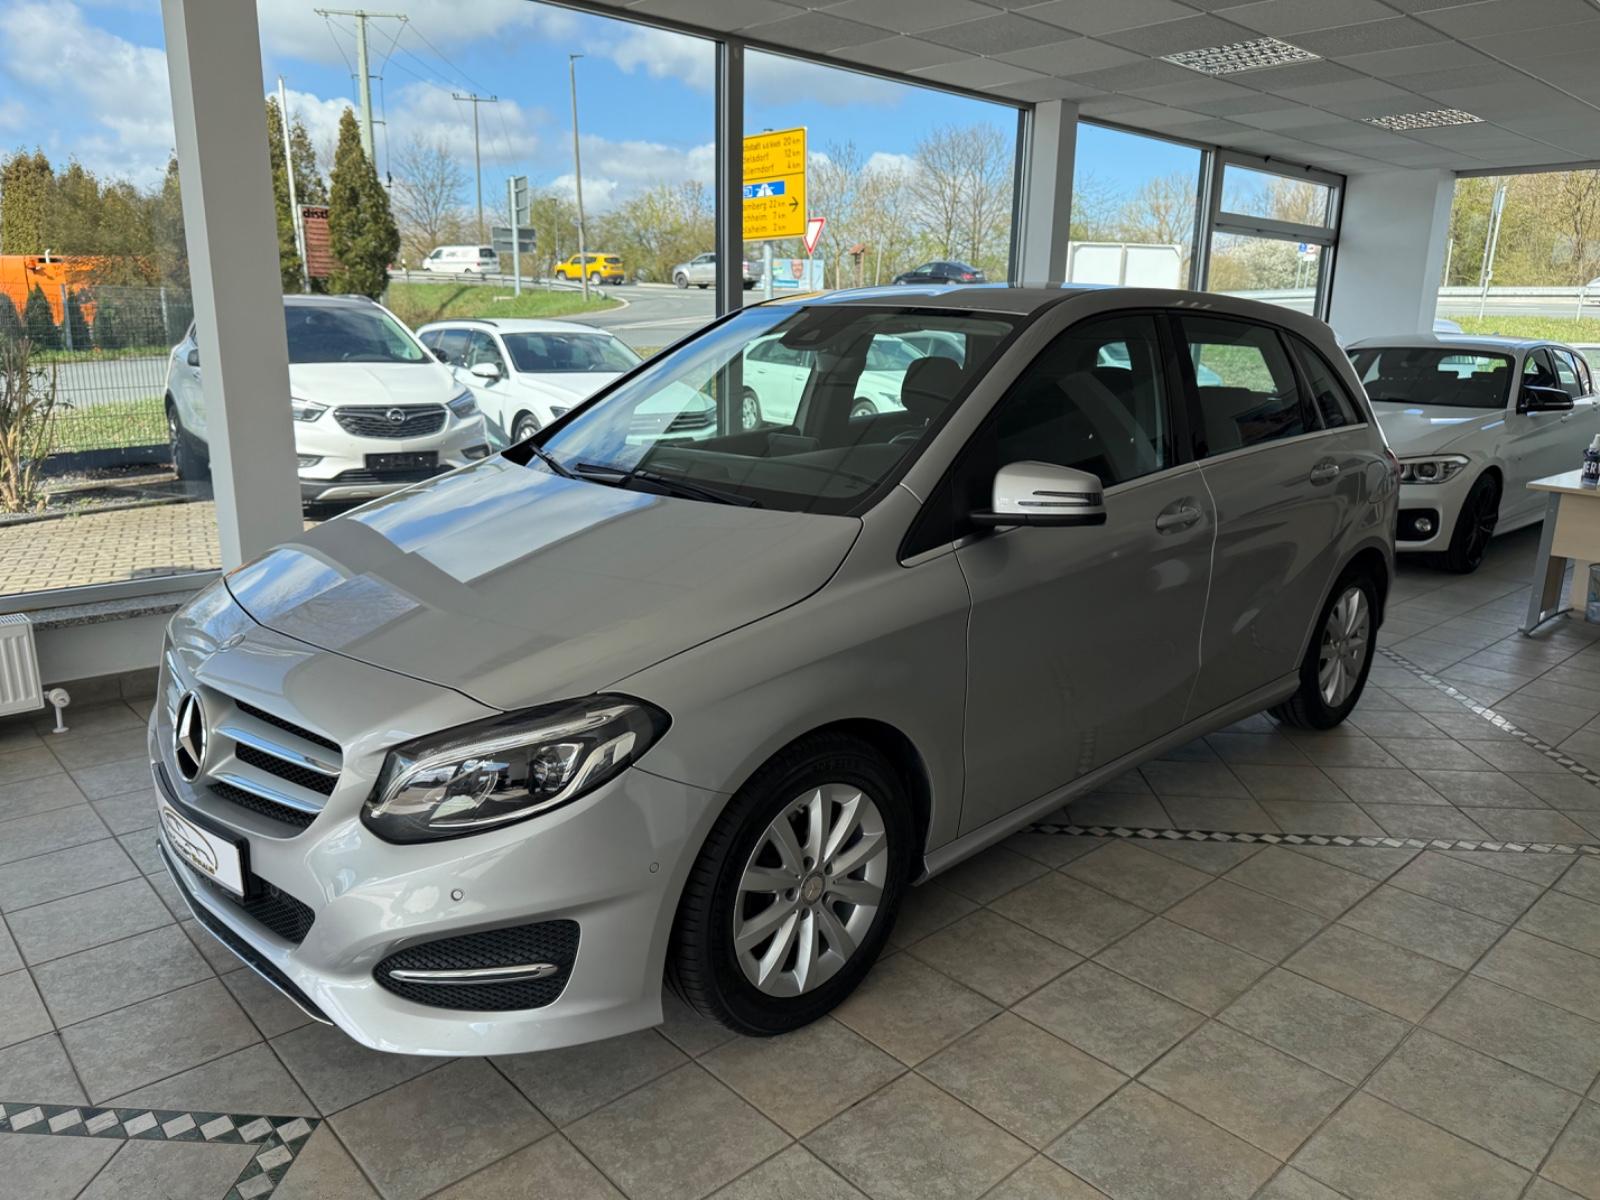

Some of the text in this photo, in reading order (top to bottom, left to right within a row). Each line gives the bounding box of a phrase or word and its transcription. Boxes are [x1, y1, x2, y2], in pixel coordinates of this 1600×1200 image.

[784, 136, 792, 146] 20
[785, 148, 792, 158] 12
[769, 199, 777, 209] 22
